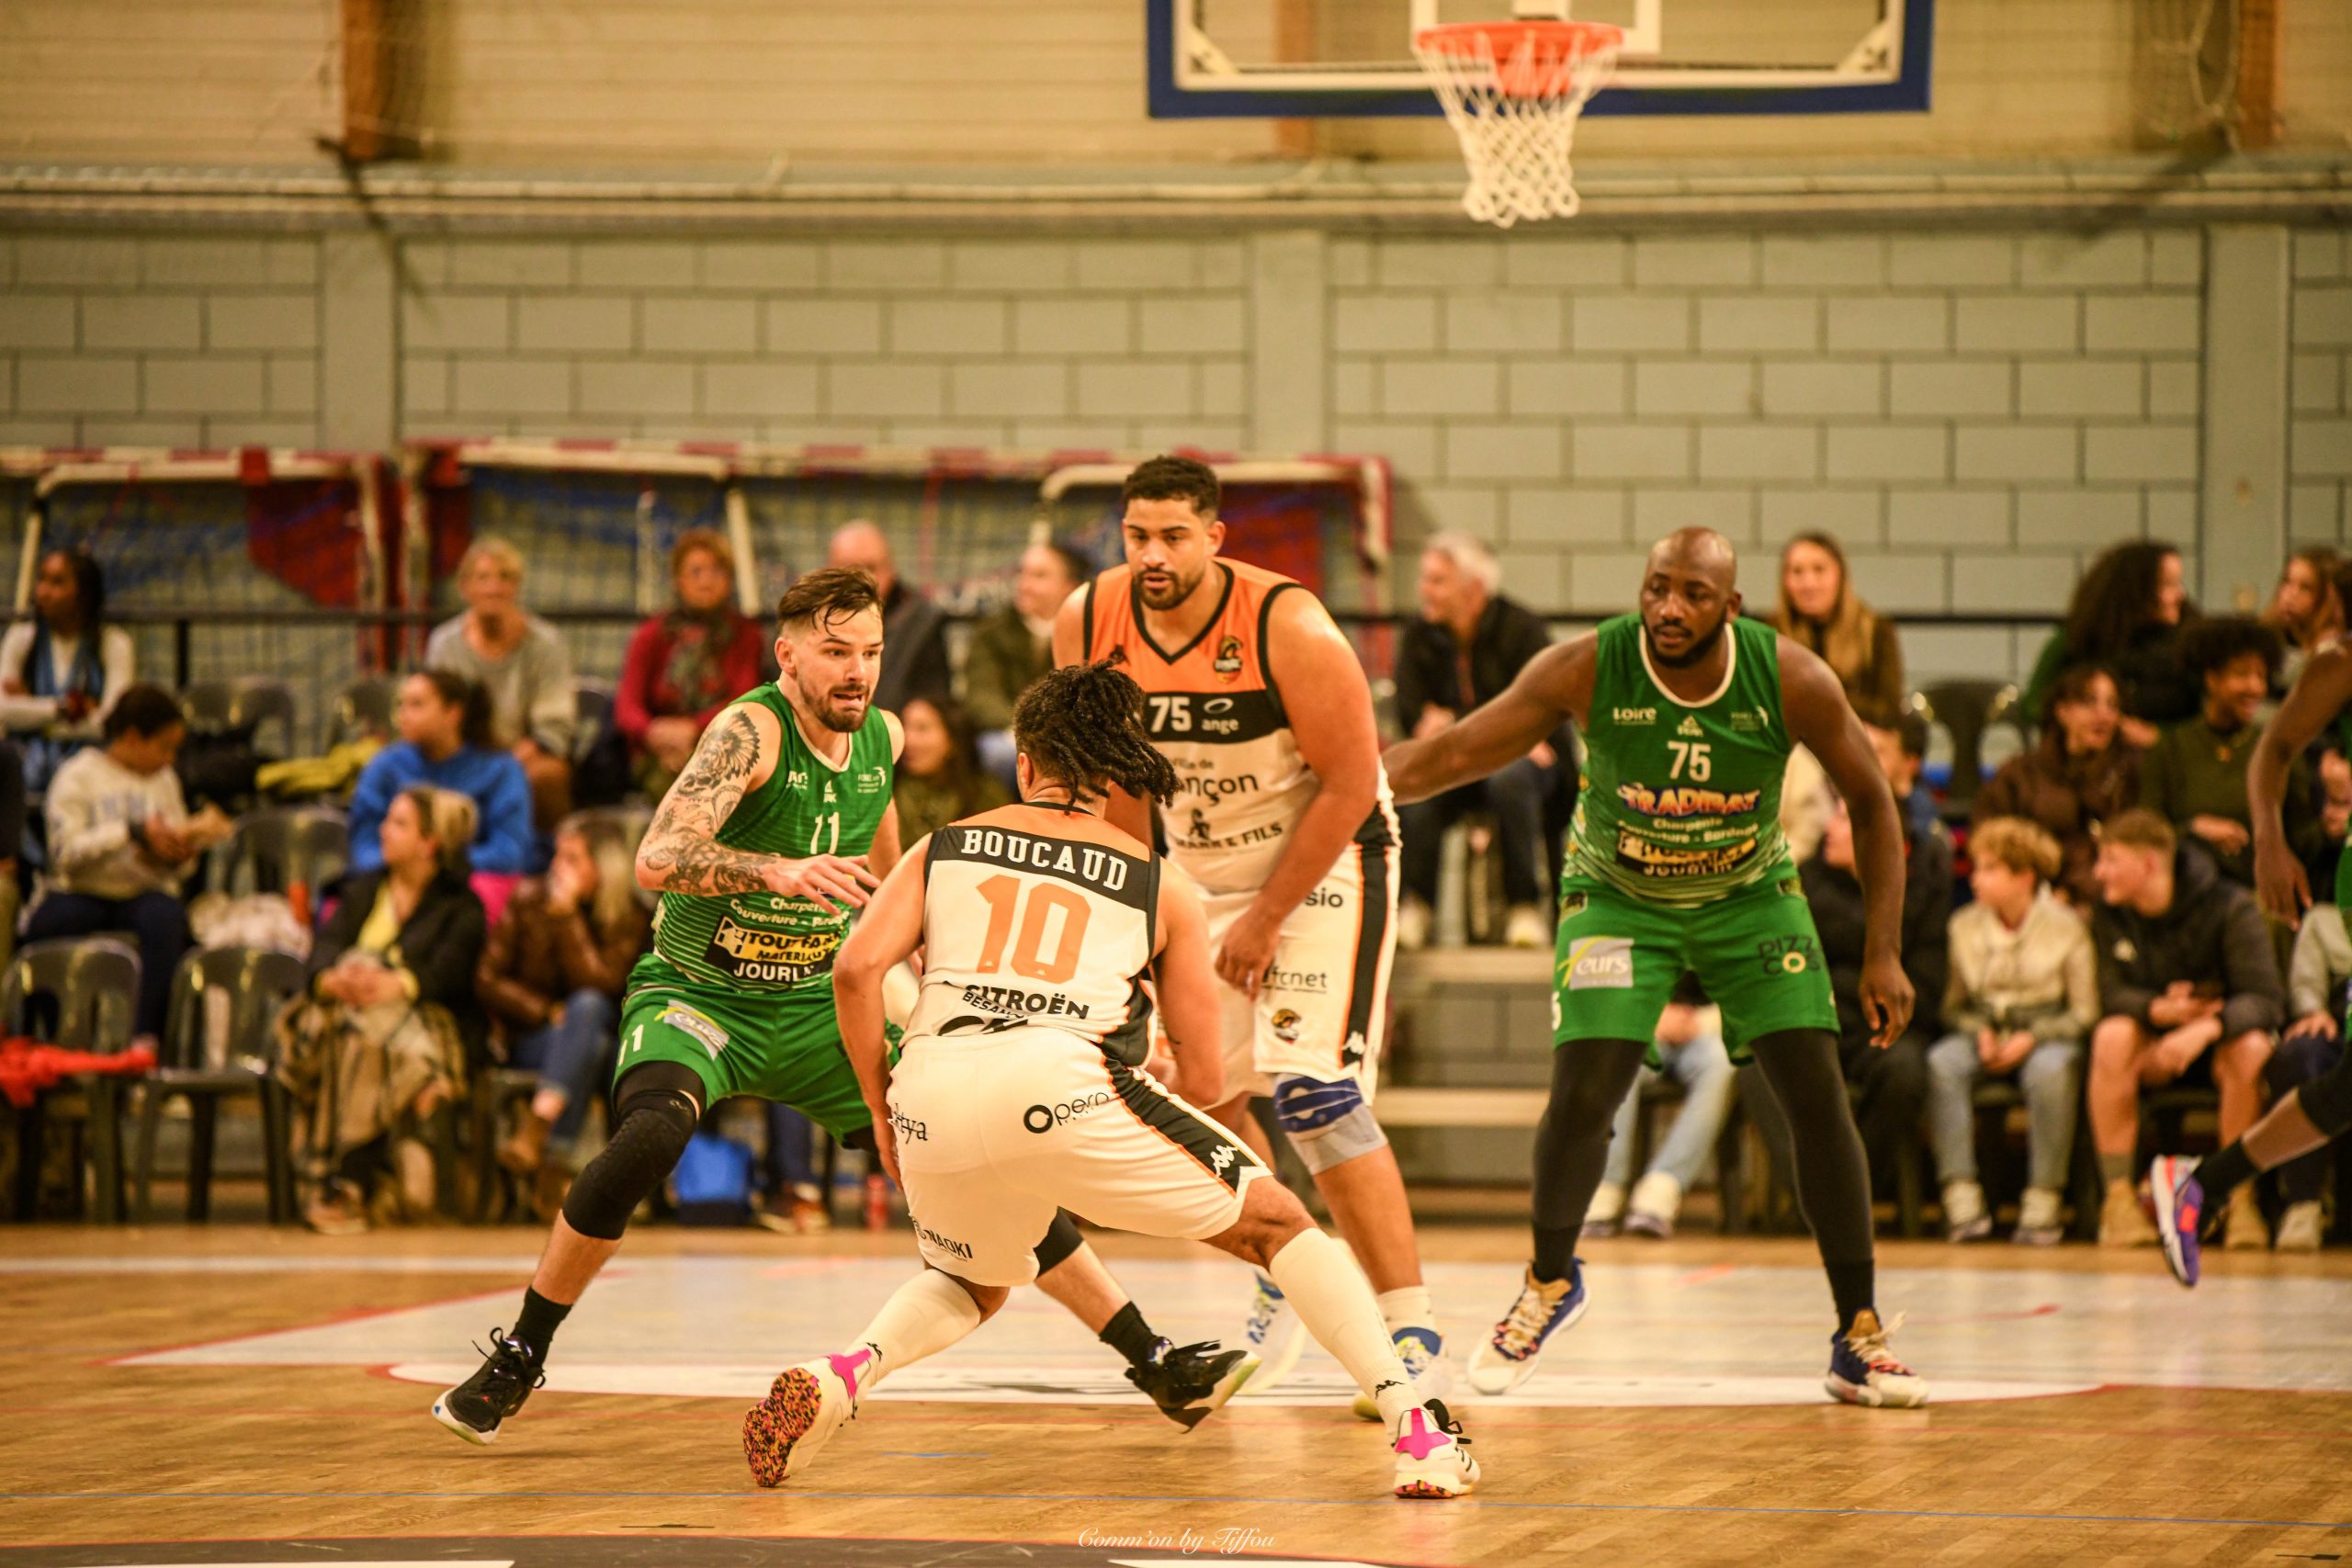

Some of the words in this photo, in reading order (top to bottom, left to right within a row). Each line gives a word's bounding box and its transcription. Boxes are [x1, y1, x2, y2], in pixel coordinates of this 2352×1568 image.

[1149, 695, 1193, 733] 75
[1202, 718, 1238, 734] ange
[1668, 740, 1712, 782] 75
[810, 811, 840, 855] 11
[1242, 822, 1283, 845] FILS
[961, 829, 1128, 891] BOUCAUD
[1305, 888, 1343, 908] sio
[976, 874, 1091, 985] 10
